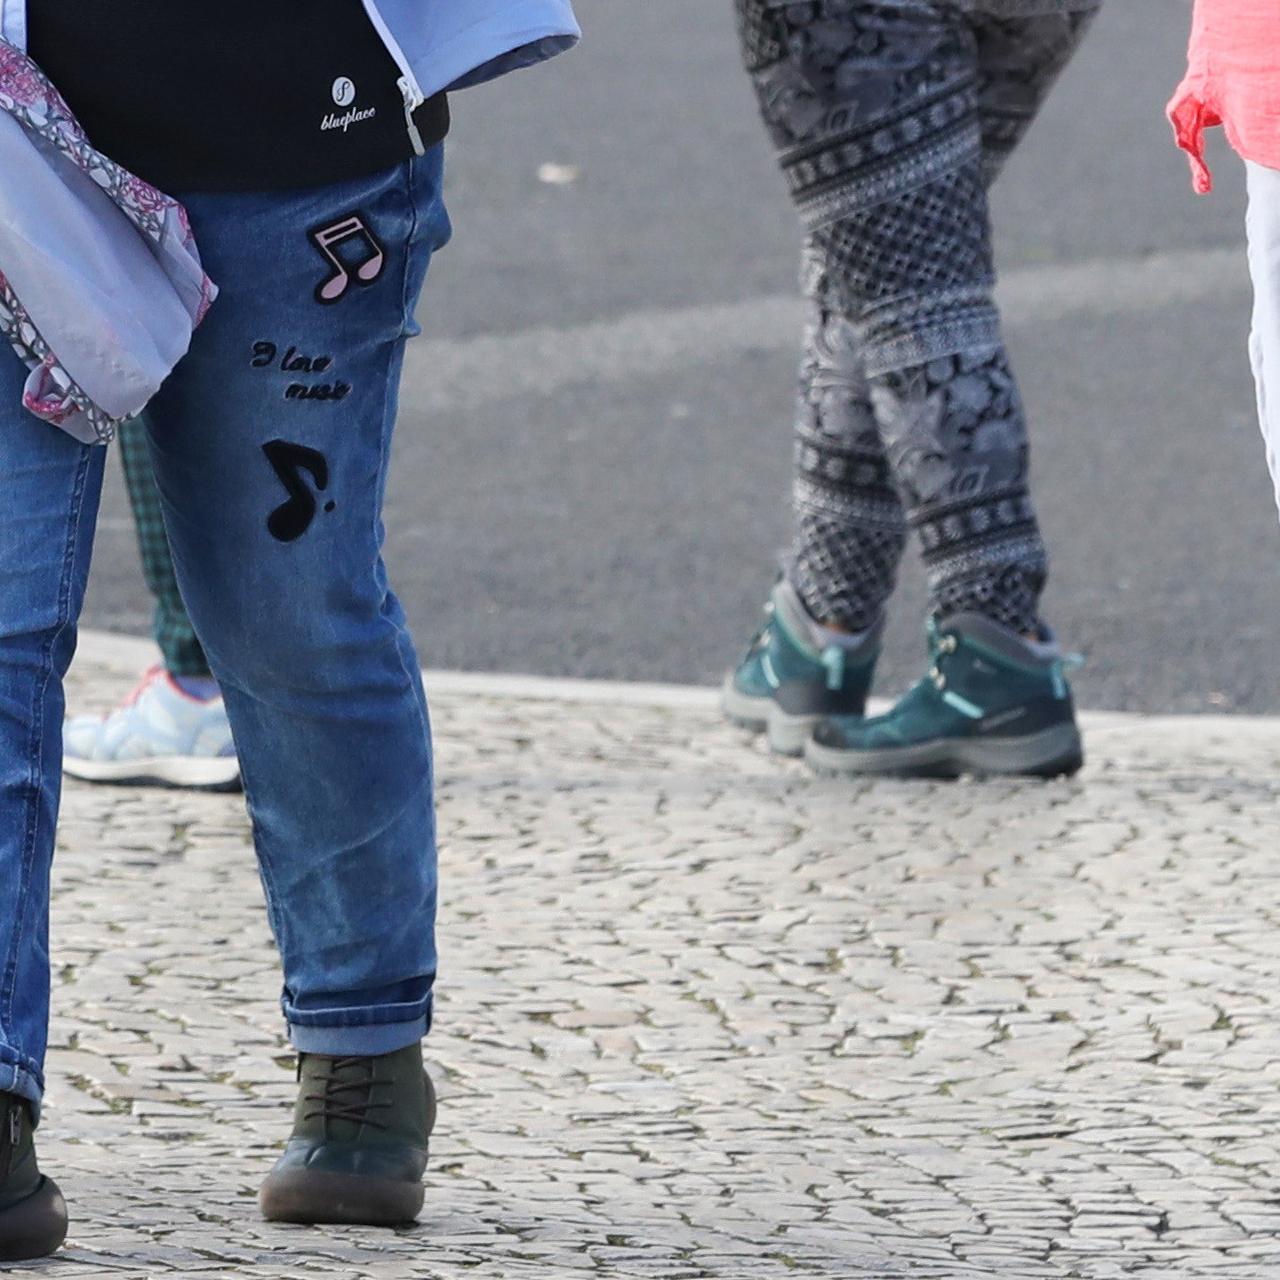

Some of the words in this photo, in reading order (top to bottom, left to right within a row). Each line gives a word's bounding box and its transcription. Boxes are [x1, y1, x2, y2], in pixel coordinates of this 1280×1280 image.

[320, 106, 377, 133] blueplace
[280, 345, 333, 373] love
[284, 380, 352, 401] music
